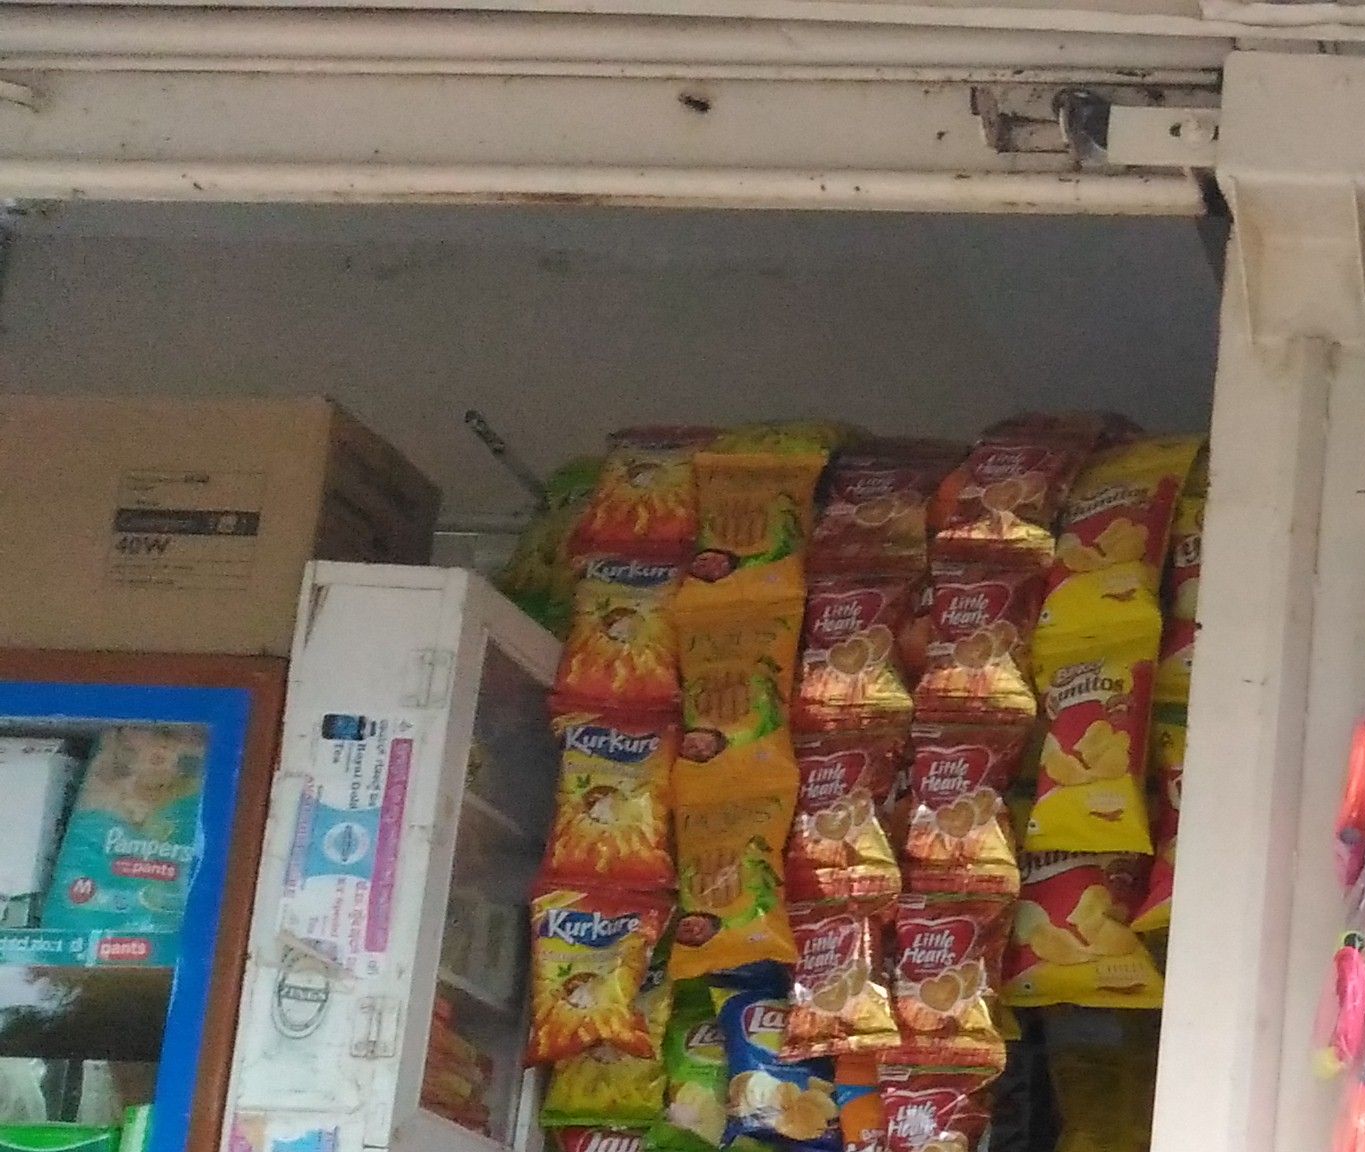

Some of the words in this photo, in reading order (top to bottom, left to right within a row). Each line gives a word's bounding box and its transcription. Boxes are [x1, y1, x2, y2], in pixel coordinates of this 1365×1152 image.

[115, 534, 172, 554] 40W
[586, 560, 679, 582] Kurkure
[823, 599, 863, 615] Little
[950, 594, 989, 610] Little
[814, 615, 863, 632] Hearts
[940, 607, 989, 625] Hearts
[565, 727, 660, 755] Kurkure
[808, 762, 848, 780] Little
[930, 758, 970, 774] Little
[801, 780, 847, 799] Hearts
[921, 776, 971, 793] Hearts
[105, 826, 194, 862] Pampers
[132, 862, 176, 878] pants
[73, 877, 93, 894] M
[548, 909, 640, 945] Kurkure
[804, 931, 840, 953] Little
[913, 929, 956, 948] Little
[100, 943, 147, 959] pants
[903, 946, 956, 965] Hearts
[801, 951, 841, 970] Hearts
